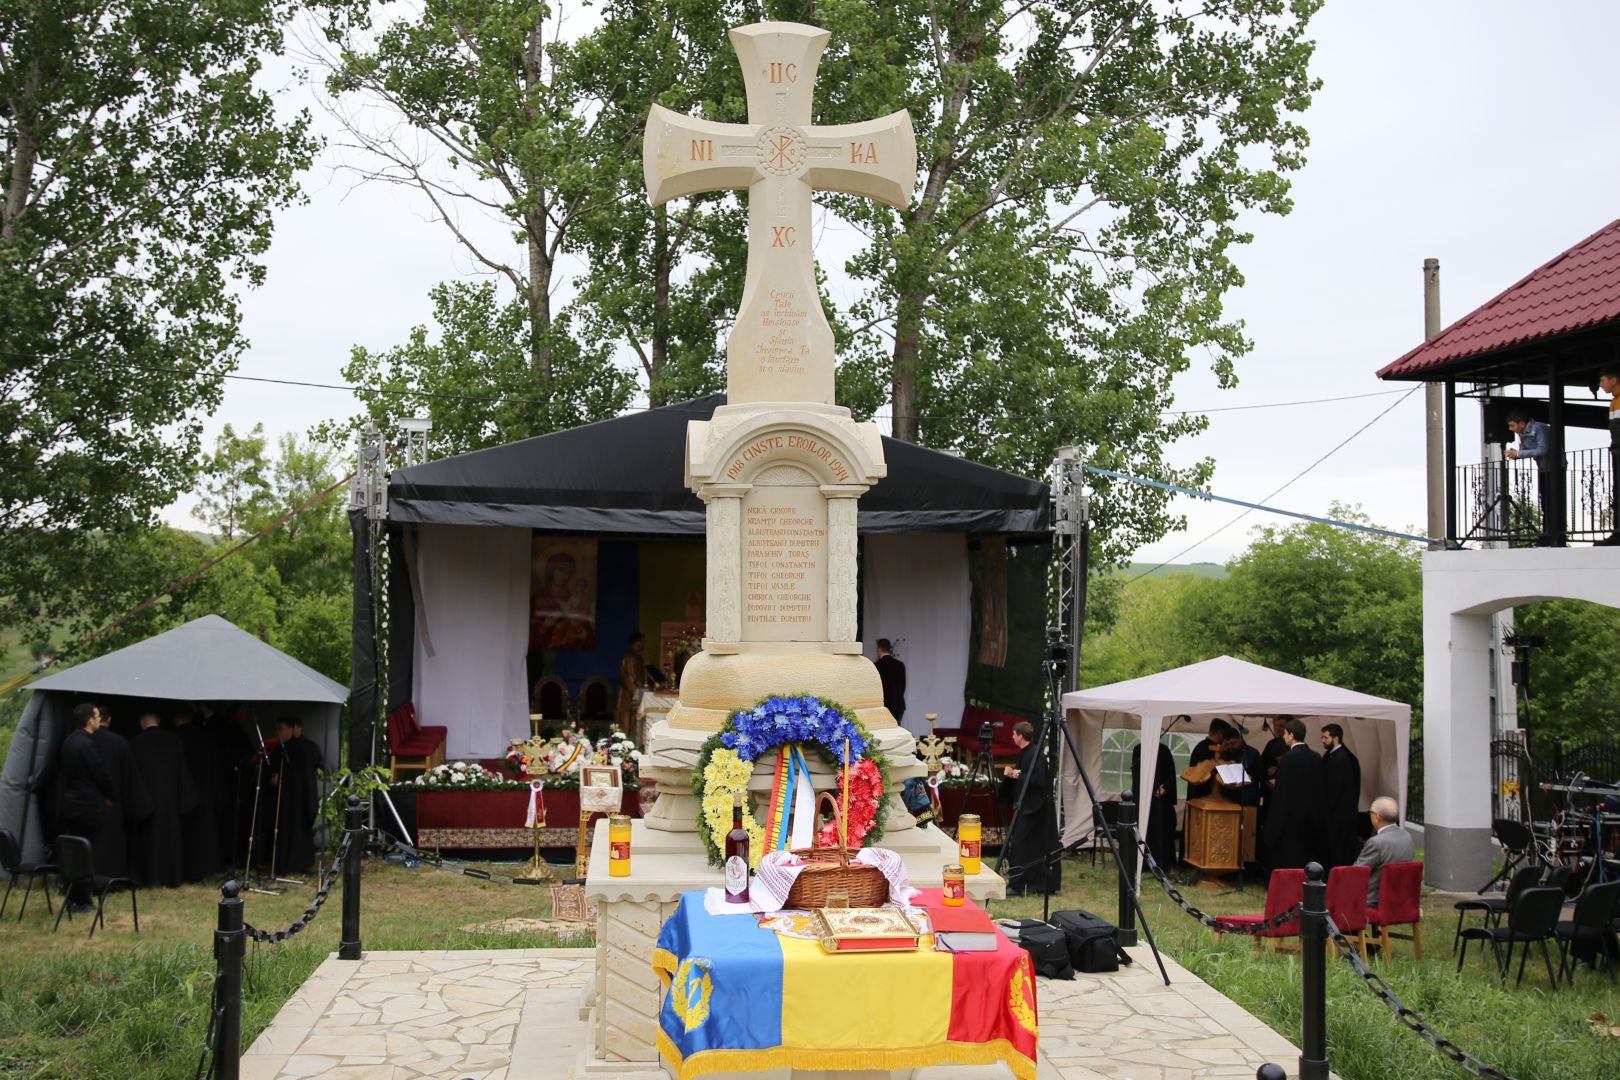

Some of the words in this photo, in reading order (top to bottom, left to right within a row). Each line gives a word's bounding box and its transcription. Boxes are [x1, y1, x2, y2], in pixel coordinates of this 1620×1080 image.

[691, 139, 713, 161] NI
[727, 459, 744, 480] 1918
[742, 436, 783, 461] CINSTE
[788, 435, 831, 461] EROILOR
[828, 458, 849, 482] 1944
[780, 518, 814, 526] GHEORGHE
[772, 561, 816, 569] CONSTANTIN
[771, 582, 795, 590] VASILE
[777, 593, 811, 601] GHEORGHE
[780, 604, 811, 612] DUMITRU
[781, 615, 811, 623] DUMITRU
[766, 818, 782, 852] ROILOR
